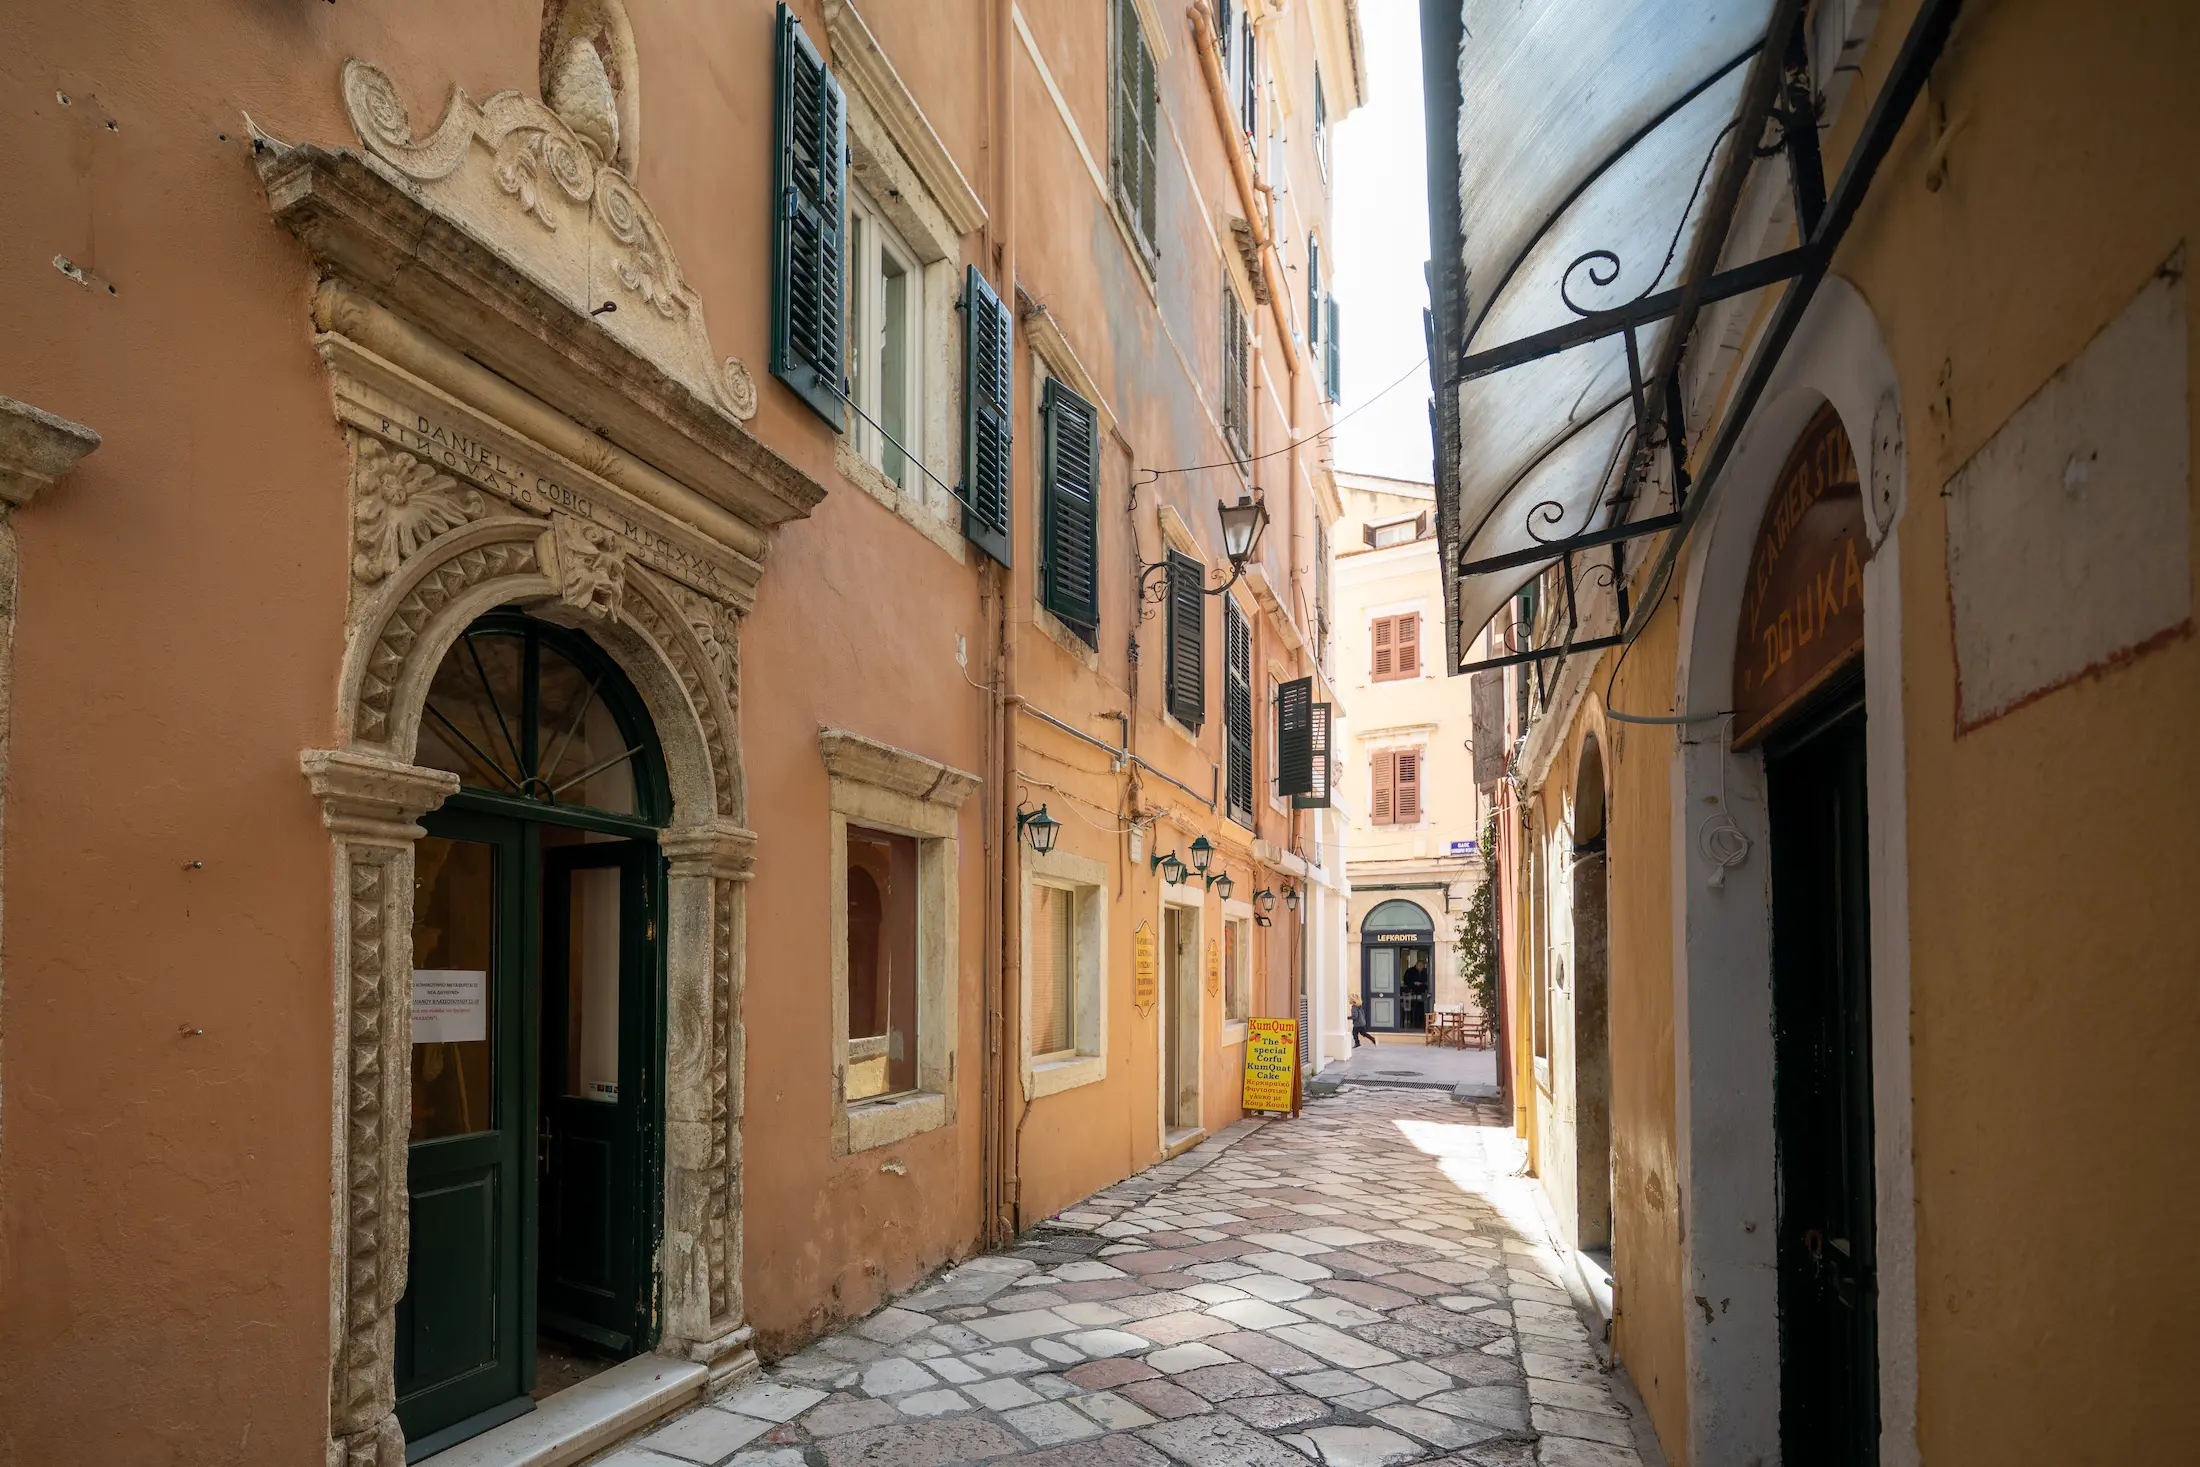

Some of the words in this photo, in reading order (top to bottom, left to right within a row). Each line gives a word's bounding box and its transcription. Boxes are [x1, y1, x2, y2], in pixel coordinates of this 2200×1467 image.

[417, 416, 507, 475] DANIEL
[536, 478, 593, 517] COBICI
[625, 520, 718, 581] MDCLXXX
[1749, 460, 1814, 643] LEATHER
[1377, 933, 1418, 942] LEFKADITIS
[1249, 1020, 1294, 1033] KumQum
[1254, 1047, 1286, 1056] special
[1247, 1063, 1291, 1072] KumQuat
